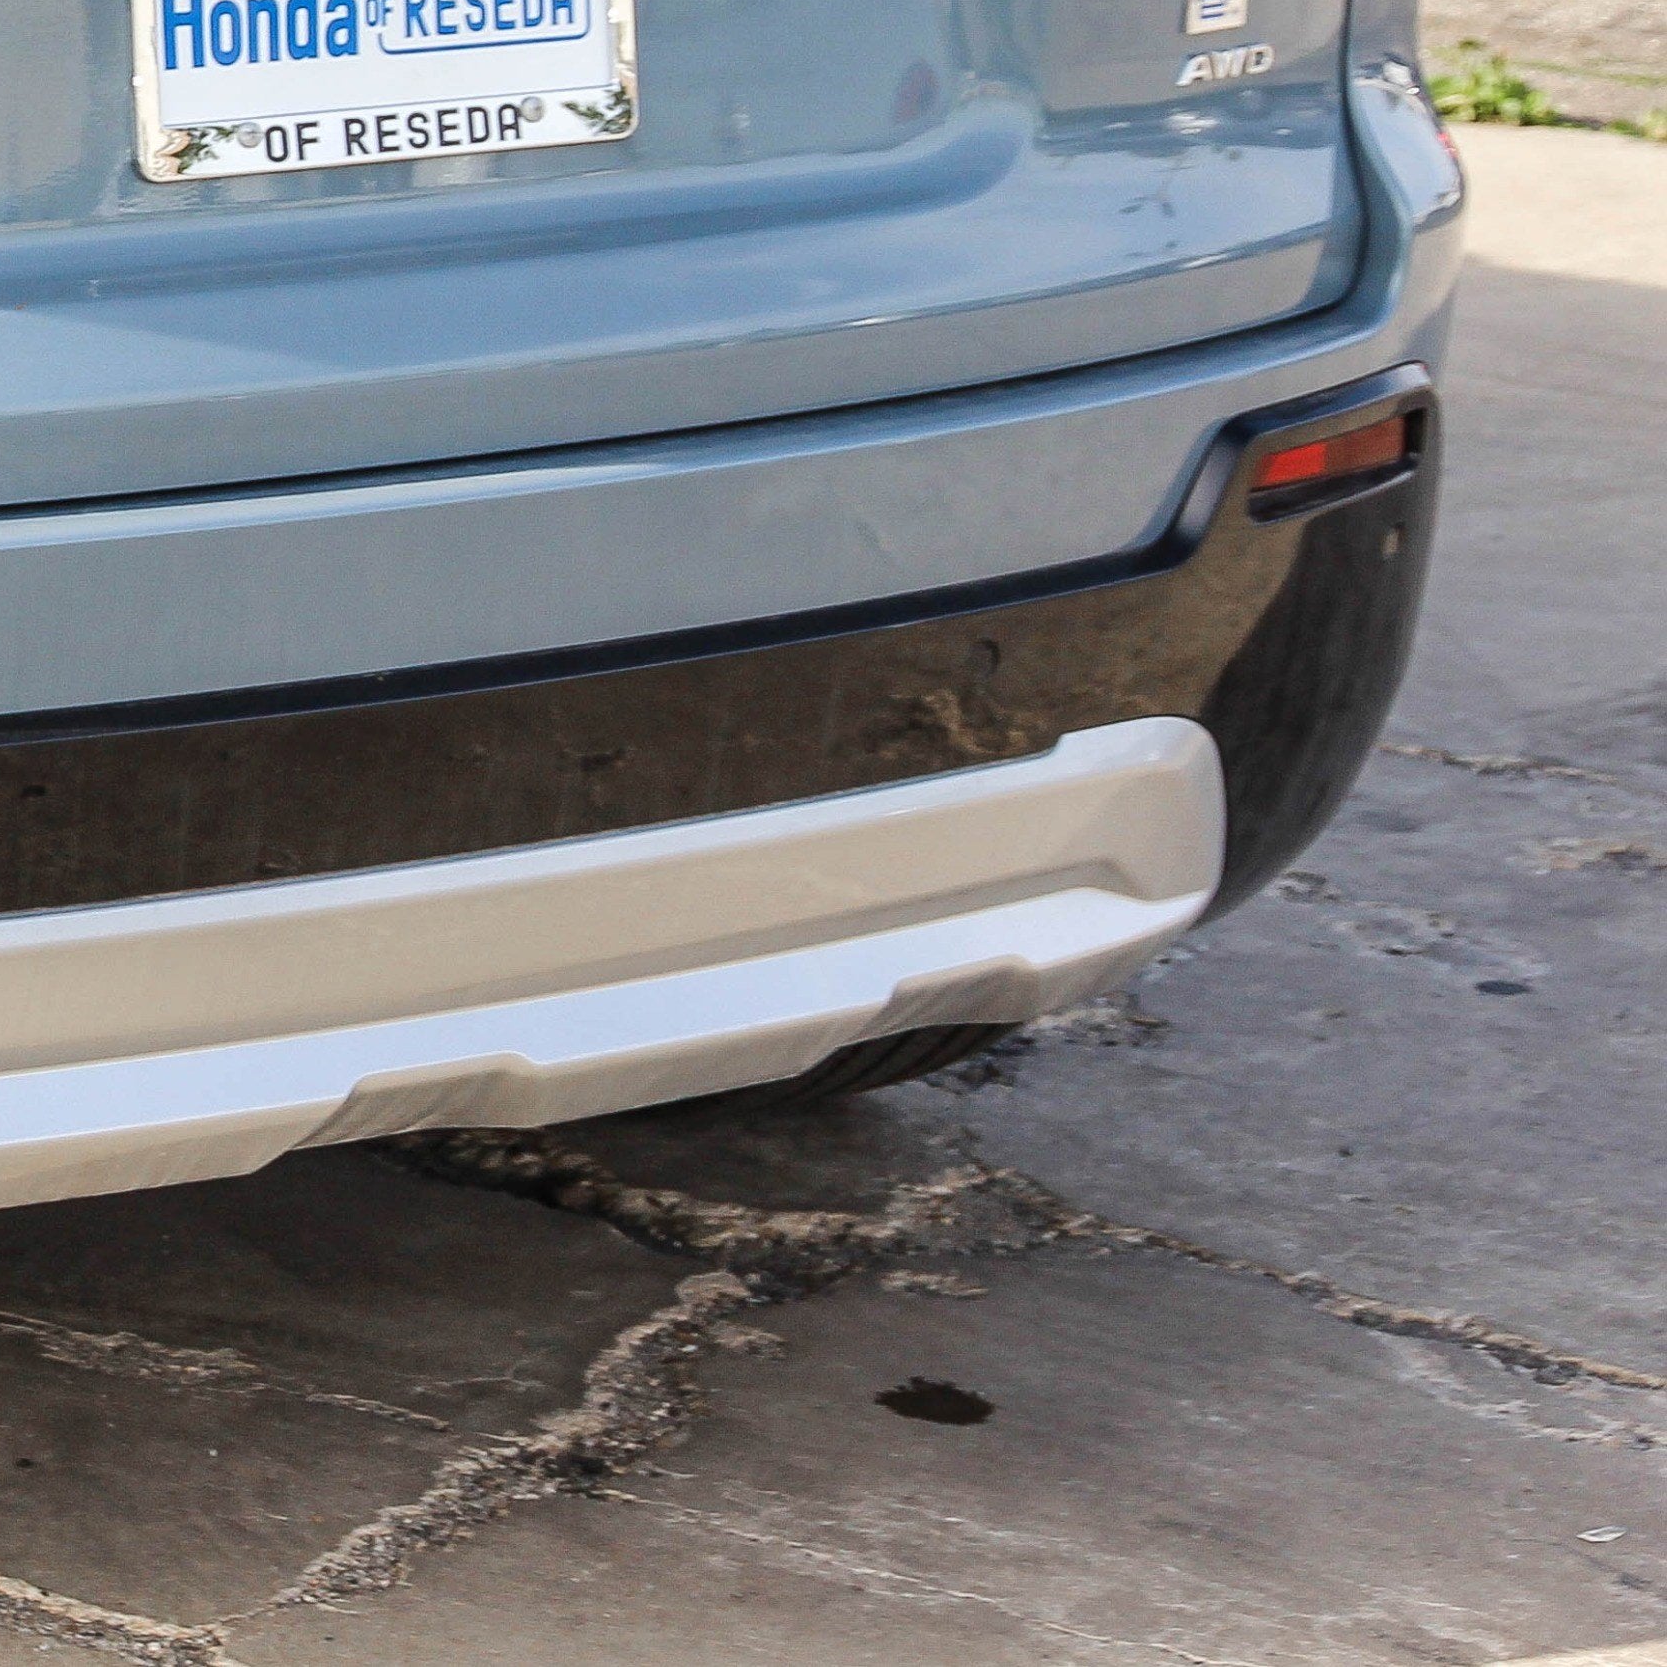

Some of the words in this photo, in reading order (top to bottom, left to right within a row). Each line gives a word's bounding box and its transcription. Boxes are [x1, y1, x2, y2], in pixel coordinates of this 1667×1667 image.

[1175, 42, 1275, 86] AWD
[265, 120, 321, 164] OF
[345, 102, 522, 158] RESEDA
